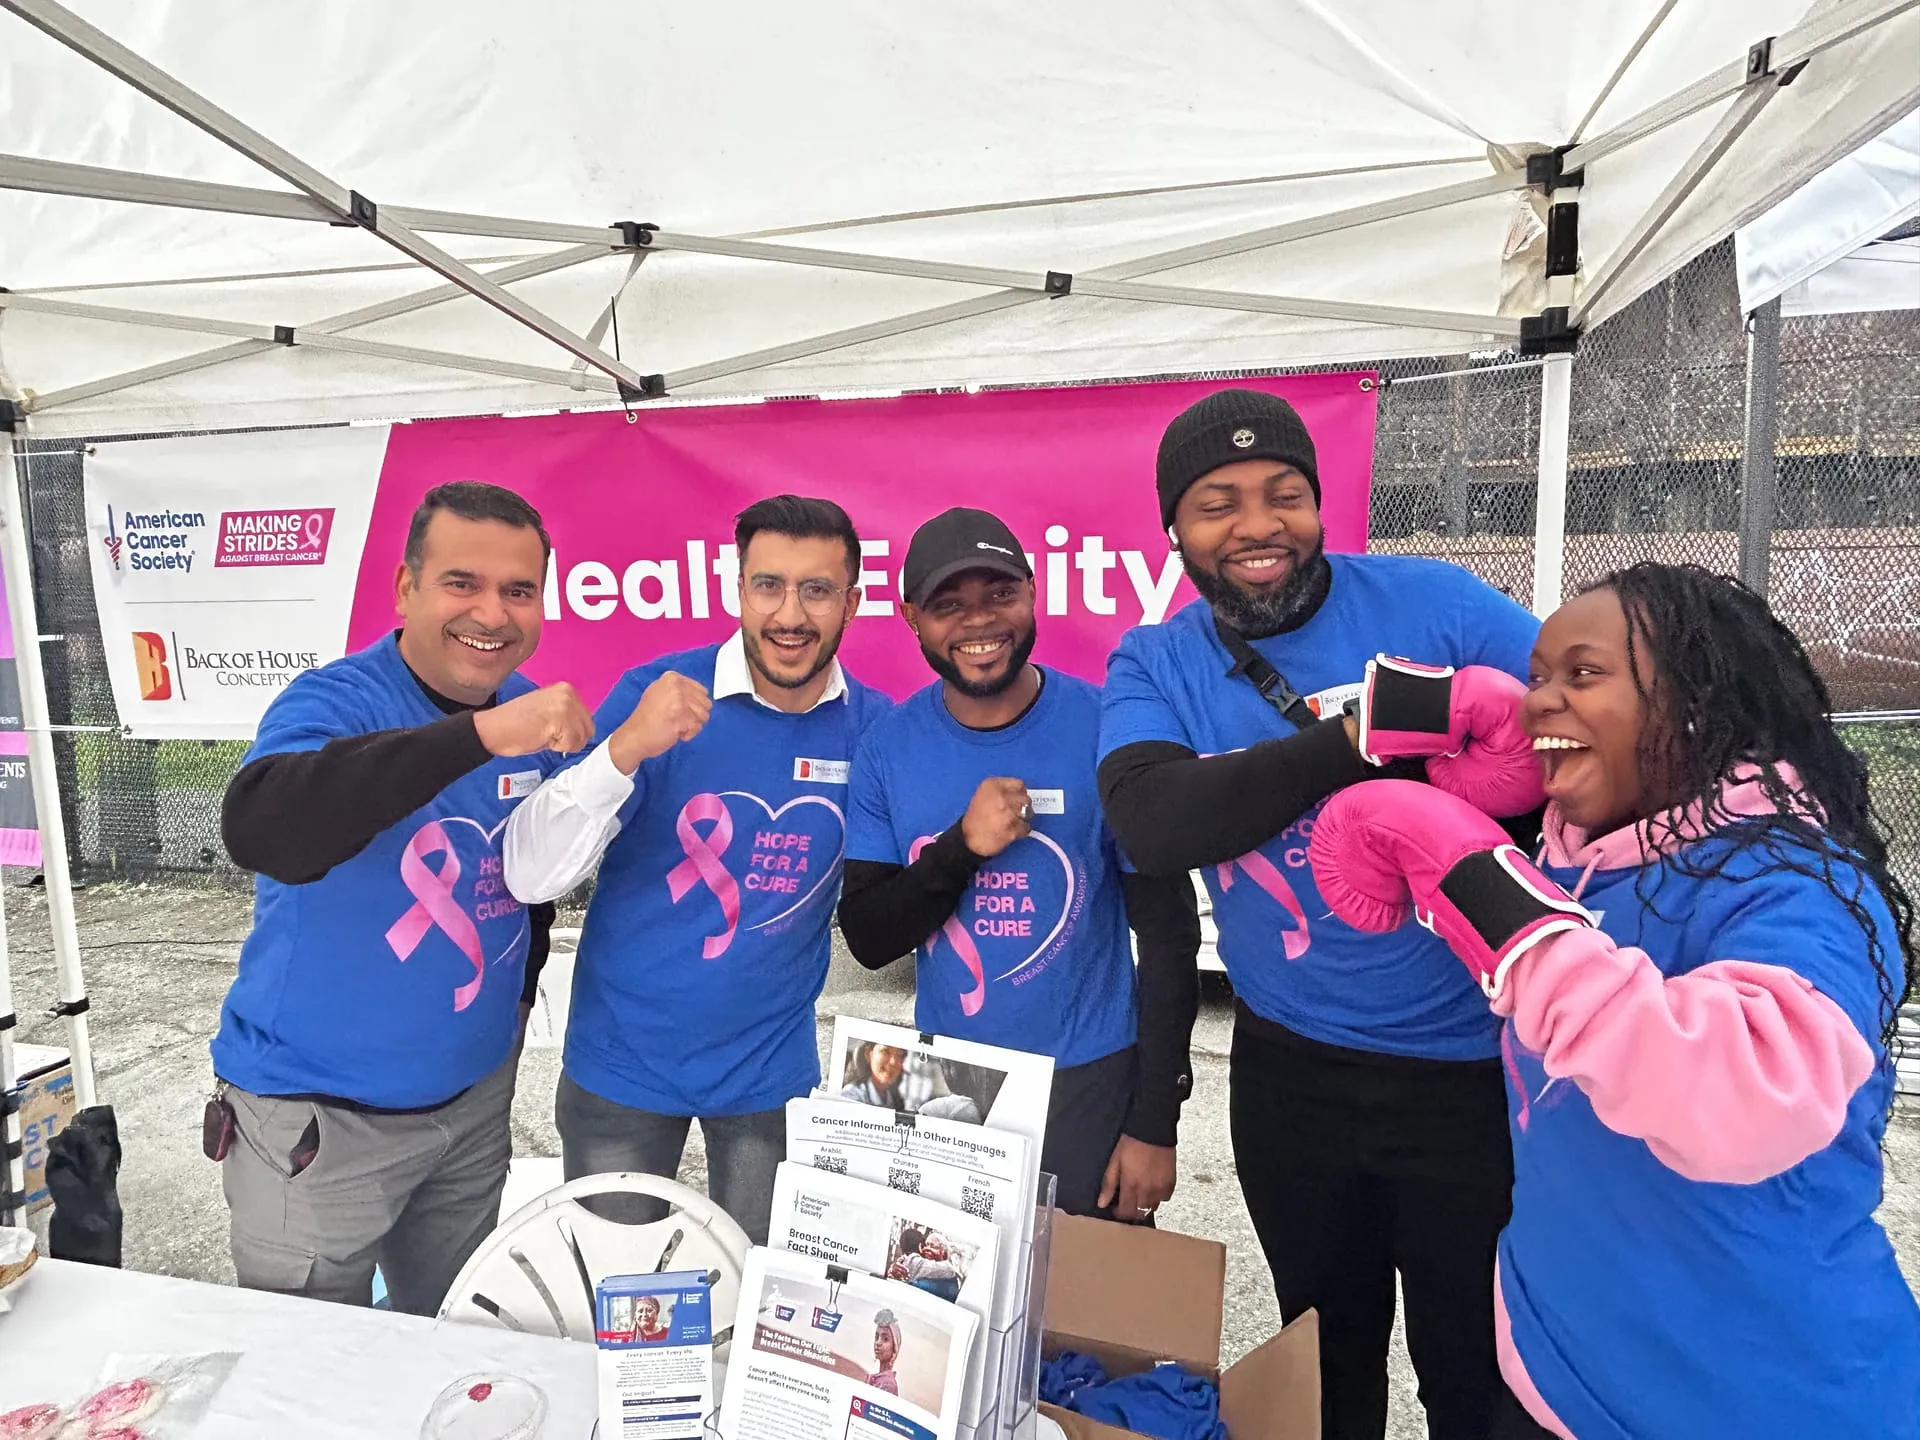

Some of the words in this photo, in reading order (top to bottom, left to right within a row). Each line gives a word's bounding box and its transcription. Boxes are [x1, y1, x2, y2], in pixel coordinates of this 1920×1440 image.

[125, 509, 205, 529] American
[226, 515, 302, 534] MAKING
[127, 532, 187, 549] Cancer
[224, 534, 298, 552] STRIDES
[220, 554, 253, 563] AGAINST
[255, 553, 284, 562] BREAST
[543, 540, 742, 621] ealt
[850, 525, 1185, 626] Eity
[232, 652, 255, 668] OF
[256, 650, 320, 668] HOUSE
[754, 831, 812, 851] HOPE
[750, 853, 791, 872] FOR
[795, 856, 808, 873] A
[745, 873, 800, 893] CURE
[975, 870, 1029, 890] HOPE
[975, 895, 1015, 913] FOR
[1020, 896, 1036, 913] A
[974, 919, 1032, 937] CURE
[1012, 958, 1049, 986] BREAST
[811, 1116, 849, 1127] Cancer
[850, 1120, 910, 1136] Information
[912, 1129, 922, 1138] in
[923, 1131, 951, 1145] Other
[952, 1137, 1006, 1158] Languages
[820, 1146, 842, 1154] Arabic
[968, 1175, 991, 1188] French
[800, 1201, 823, 1212] Cancer
[801, 1194, 830, 1207] American
[800, 1207, 823, 1219] Society
[789, 1228, 821, 1245] Breast
[823, 1237, 859, 1255] Cancer
[787, 1240, 809, 1254] Fact
[810, 1246, 839, 1263] Sheet
